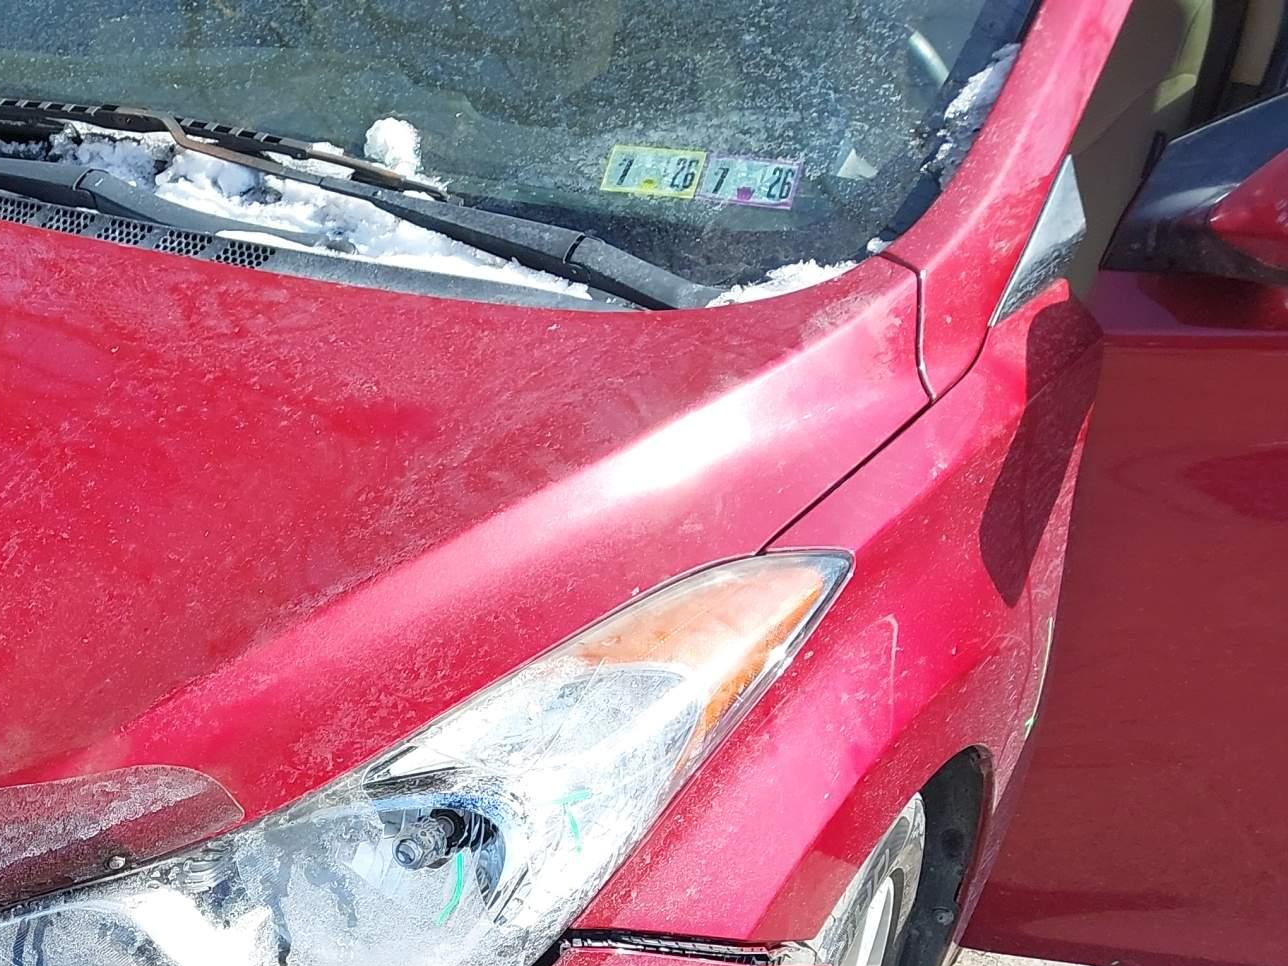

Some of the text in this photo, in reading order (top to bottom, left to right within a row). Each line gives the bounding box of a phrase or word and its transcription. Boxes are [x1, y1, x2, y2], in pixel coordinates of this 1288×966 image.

[669, 157, 700, 189] 26
[712, 166, 795, 199] 7 26
